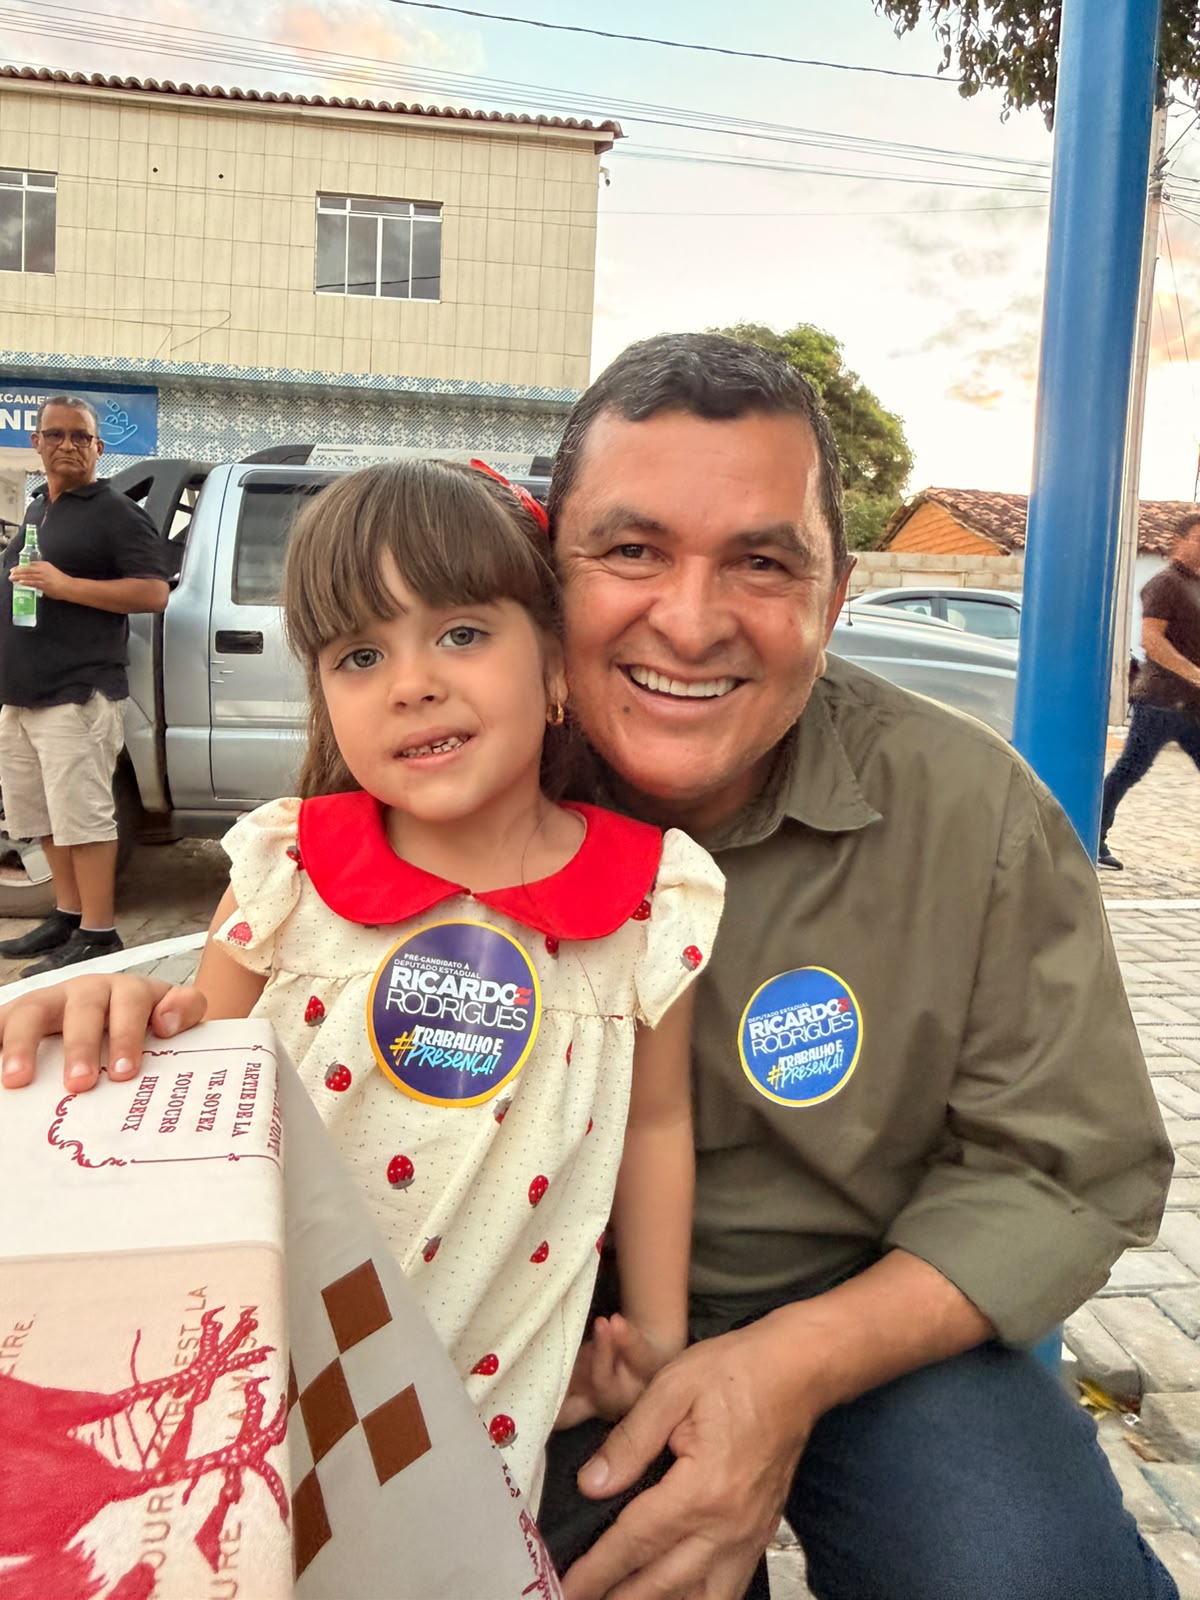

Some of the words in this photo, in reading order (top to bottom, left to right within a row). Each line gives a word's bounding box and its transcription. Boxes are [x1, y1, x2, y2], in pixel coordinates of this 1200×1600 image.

[390, 965, 519, 1006] RICARDO
[394, 959, 438, 971] DEPUTADO
[438, 966, 481, 979] ESTADUAL
[385, 988, 528, 1031] RODRIGUES
[748, 1010, 779, 1023] DEPUTADO
[780, 1002, 809, 1014] ESTADUAL
[749, 998, 841, 1039] RICARDO
[751, 1012, 854, 1056] RODRIGUES
[404, 1043, 500, 1076] PRESENÇA!
[781, 1049, 844, 1088] PRESENÇA!
[241, 1062, 262, 1100] PARTIE
[120, 1075, 160, 1133] HEUREUX
[158, 1071, 194, 1134] TOUJOURS
[195, 1093, 221, 1133] SOYEZ
[238, 1103, 253, 1119] DE
[231, 1121, 250, 1138] LA
[185, 1286, 208, 1311] LA
[173, 1324, 201, 1367] EST
